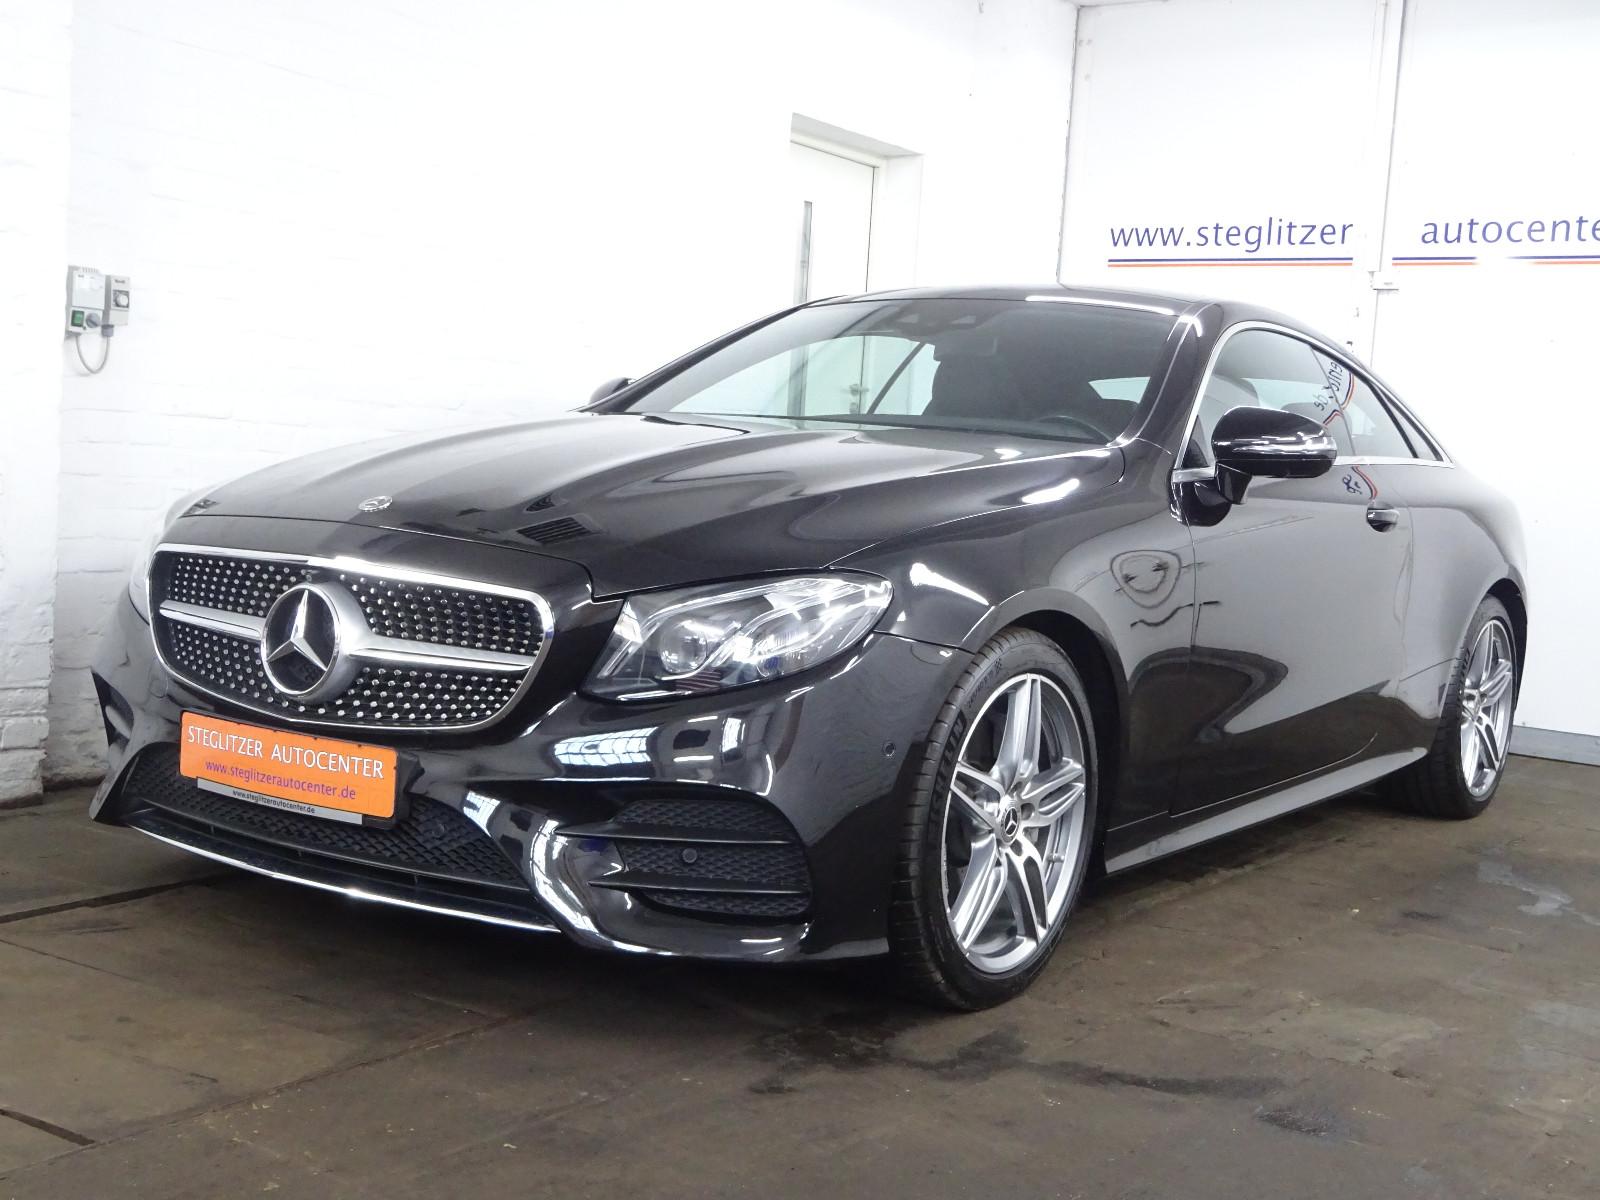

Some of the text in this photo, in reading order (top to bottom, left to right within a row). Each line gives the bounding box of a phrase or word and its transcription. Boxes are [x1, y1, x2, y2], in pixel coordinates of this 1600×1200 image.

[1110, 216, 1354, 253] www.steglitzer
[187, 725, 384, 779] STEGLITZER AUTOCENTER
[232, 790, 316, 814] www.steglitzerautocenter.de
